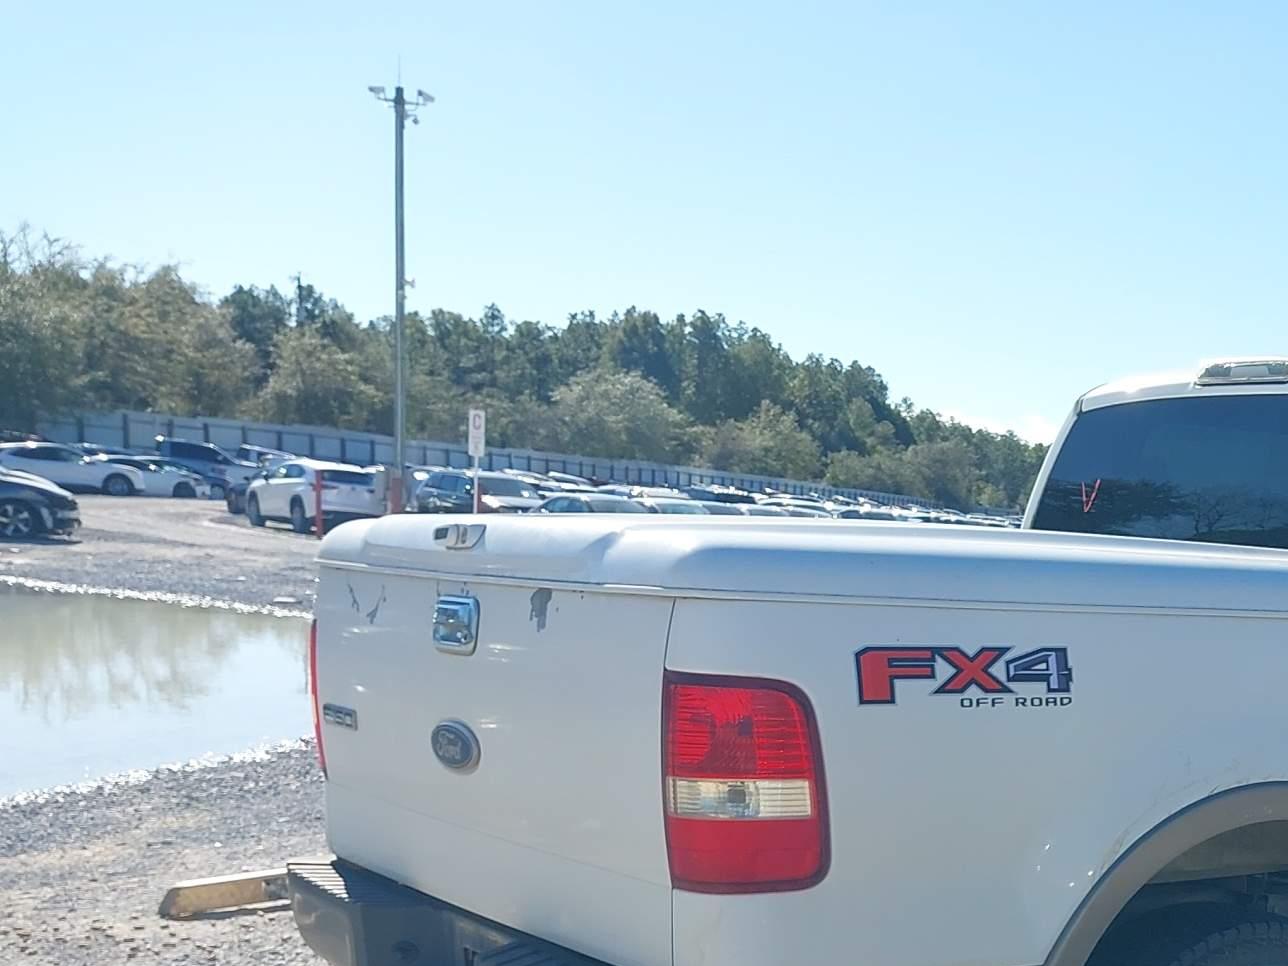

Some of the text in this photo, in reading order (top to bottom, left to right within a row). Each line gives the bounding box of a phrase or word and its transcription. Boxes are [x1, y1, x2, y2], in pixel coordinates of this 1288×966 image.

[855, 646, 1073, 705] FX4
[960, 696, 1073, 708] OFF ROAD
